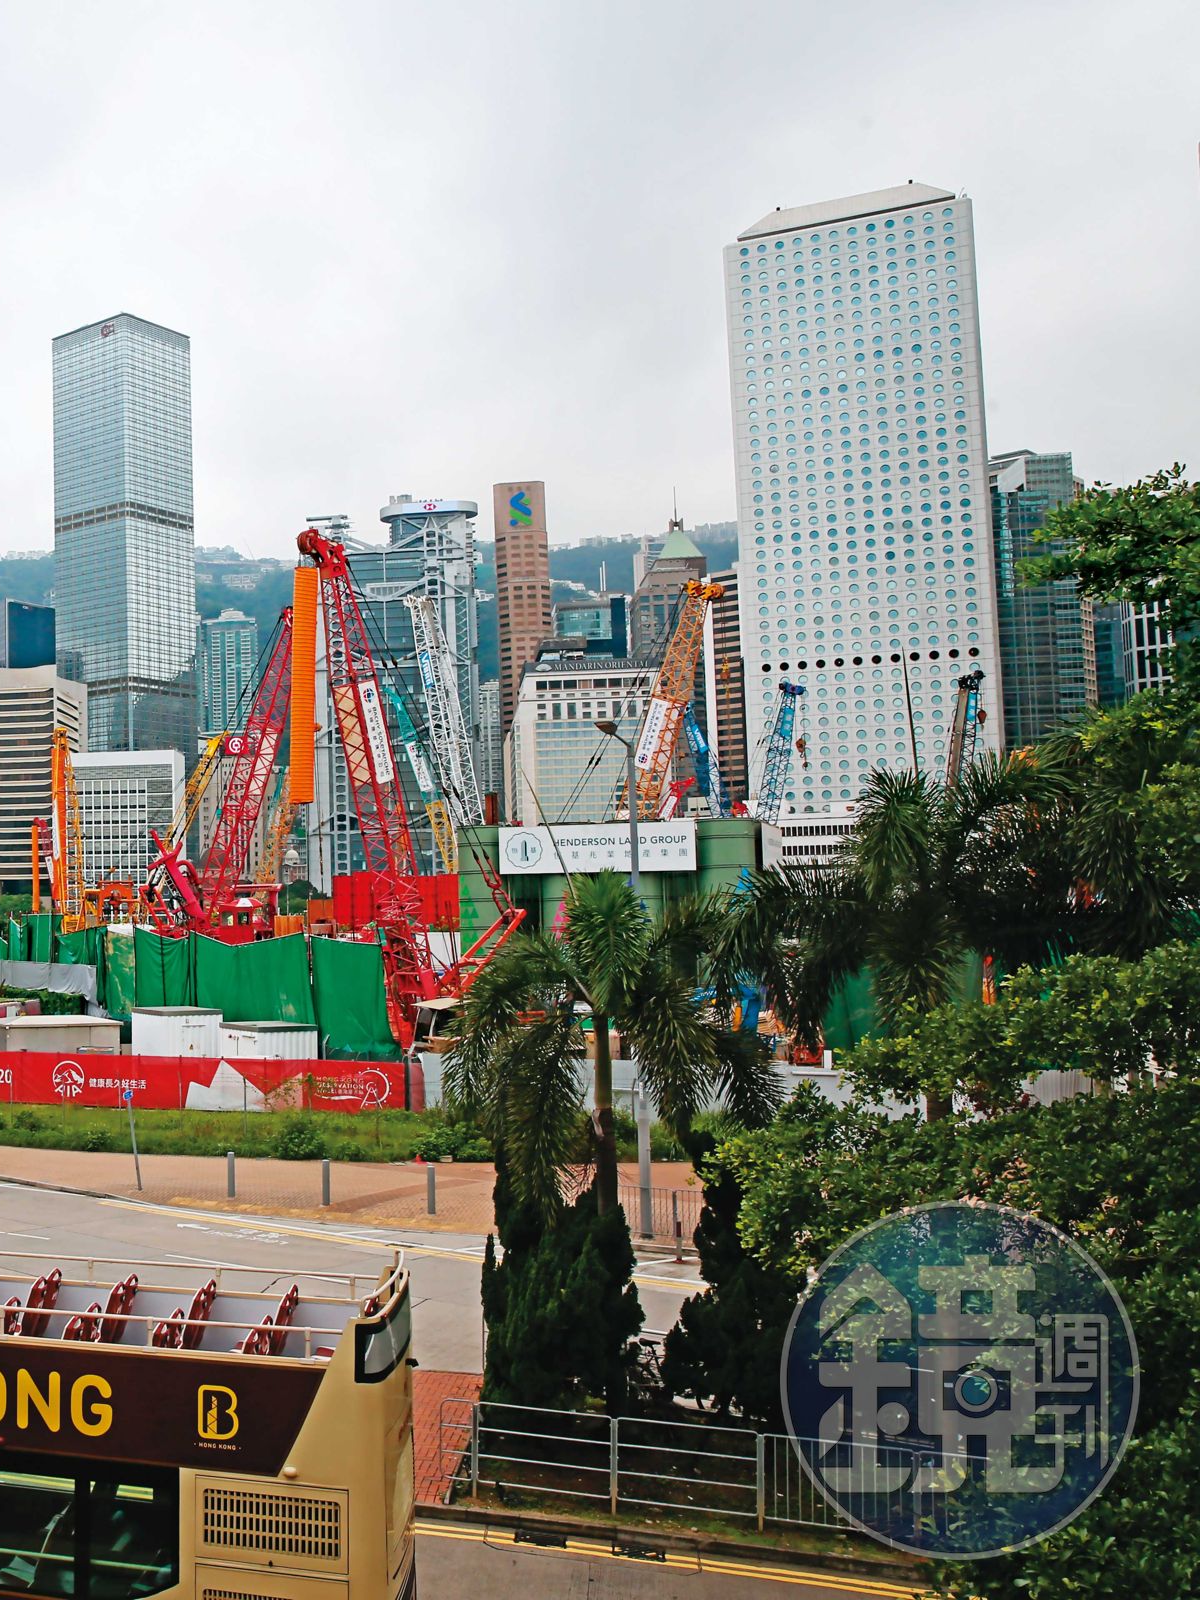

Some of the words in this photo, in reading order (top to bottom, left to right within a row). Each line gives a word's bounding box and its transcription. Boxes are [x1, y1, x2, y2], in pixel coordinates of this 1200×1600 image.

[554, 662, 603, 671] MANDARIN
[604, 660, 649, 669] ORIENTAL
[554, 837, 615, 847] HENDERSON
[619, 836, 647, 846] LAD
[650, 835, 687, 844] GROUP
[89, 1078, 147, 1090] 健康長久好生活
[54, 1084, 82, 1097] AIA
